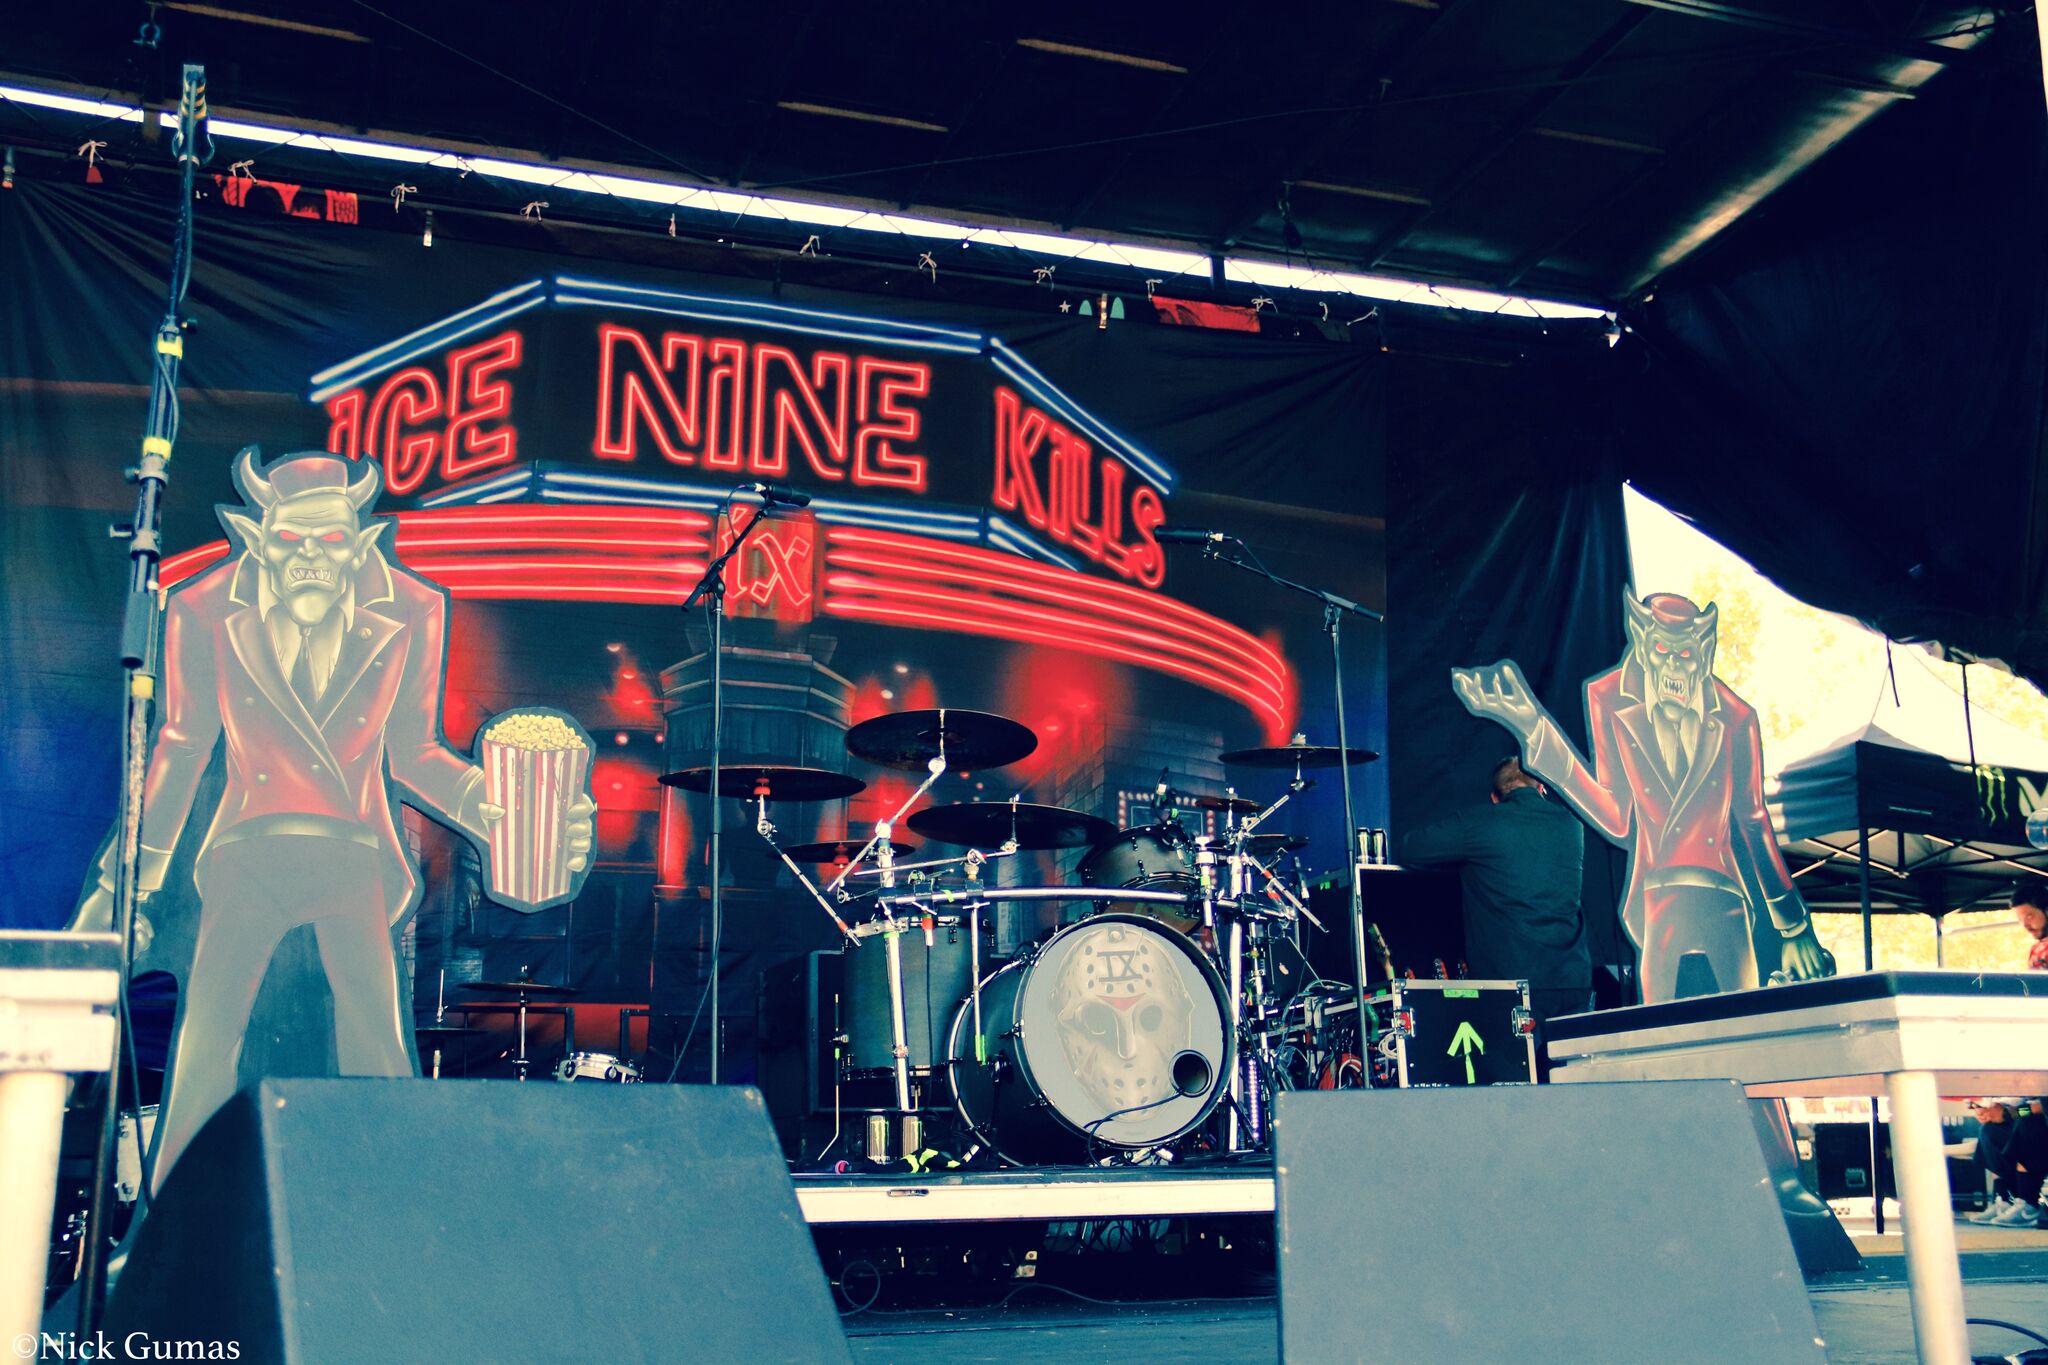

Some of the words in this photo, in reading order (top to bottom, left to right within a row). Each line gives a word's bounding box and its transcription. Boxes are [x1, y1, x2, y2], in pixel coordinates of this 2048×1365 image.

[328, 330, 523, 495] ICE
[594, 322, 931, 493] NINE
[993, 385, 1166, 589] KILLS
[1096, 949, 1144, 984] IX
